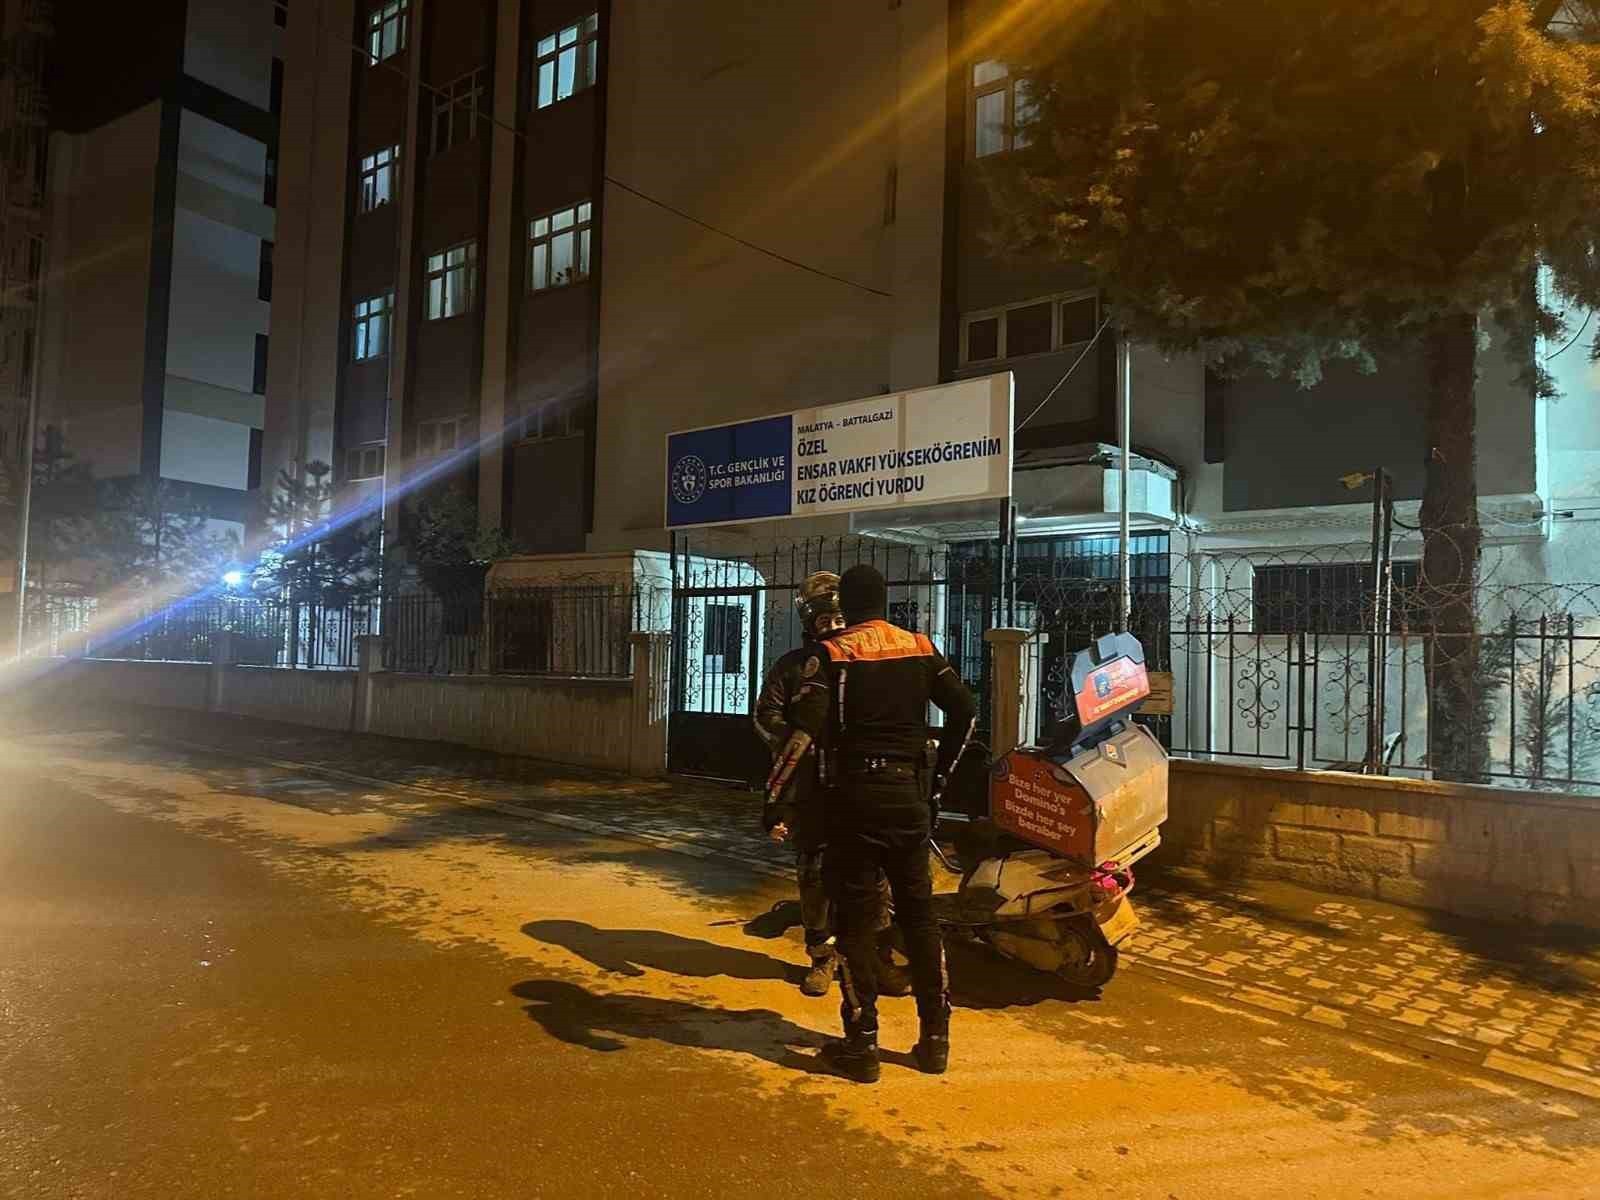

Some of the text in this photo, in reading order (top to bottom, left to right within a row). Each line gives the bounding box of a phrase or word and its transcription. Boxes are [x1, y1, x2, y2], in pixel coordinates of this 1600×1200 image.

[798, 421, 834, 434] MALATYA
[842, 411, 893, 427] BATTALGAZİ
[797, 438, 828, 457] ÖZEL
[797, 436, 1001, 481] ENSAR VAKFI YÜKSEKÖĞRENİM
[709, 455, 785, 476] T.C. GENÇLİK VE
[708, 470, 785, 490] SPOR BAKANLIĞI
[797, 475, 924, 505] KIZ ÖĞRENCİ YURDU
[1008, 773, 1031, 791] Bize
[1032, 782, 1052, 798] her
[1005, 799, 1034, 820] Bizde
[1015, 787, 1066, 816] Domino's
